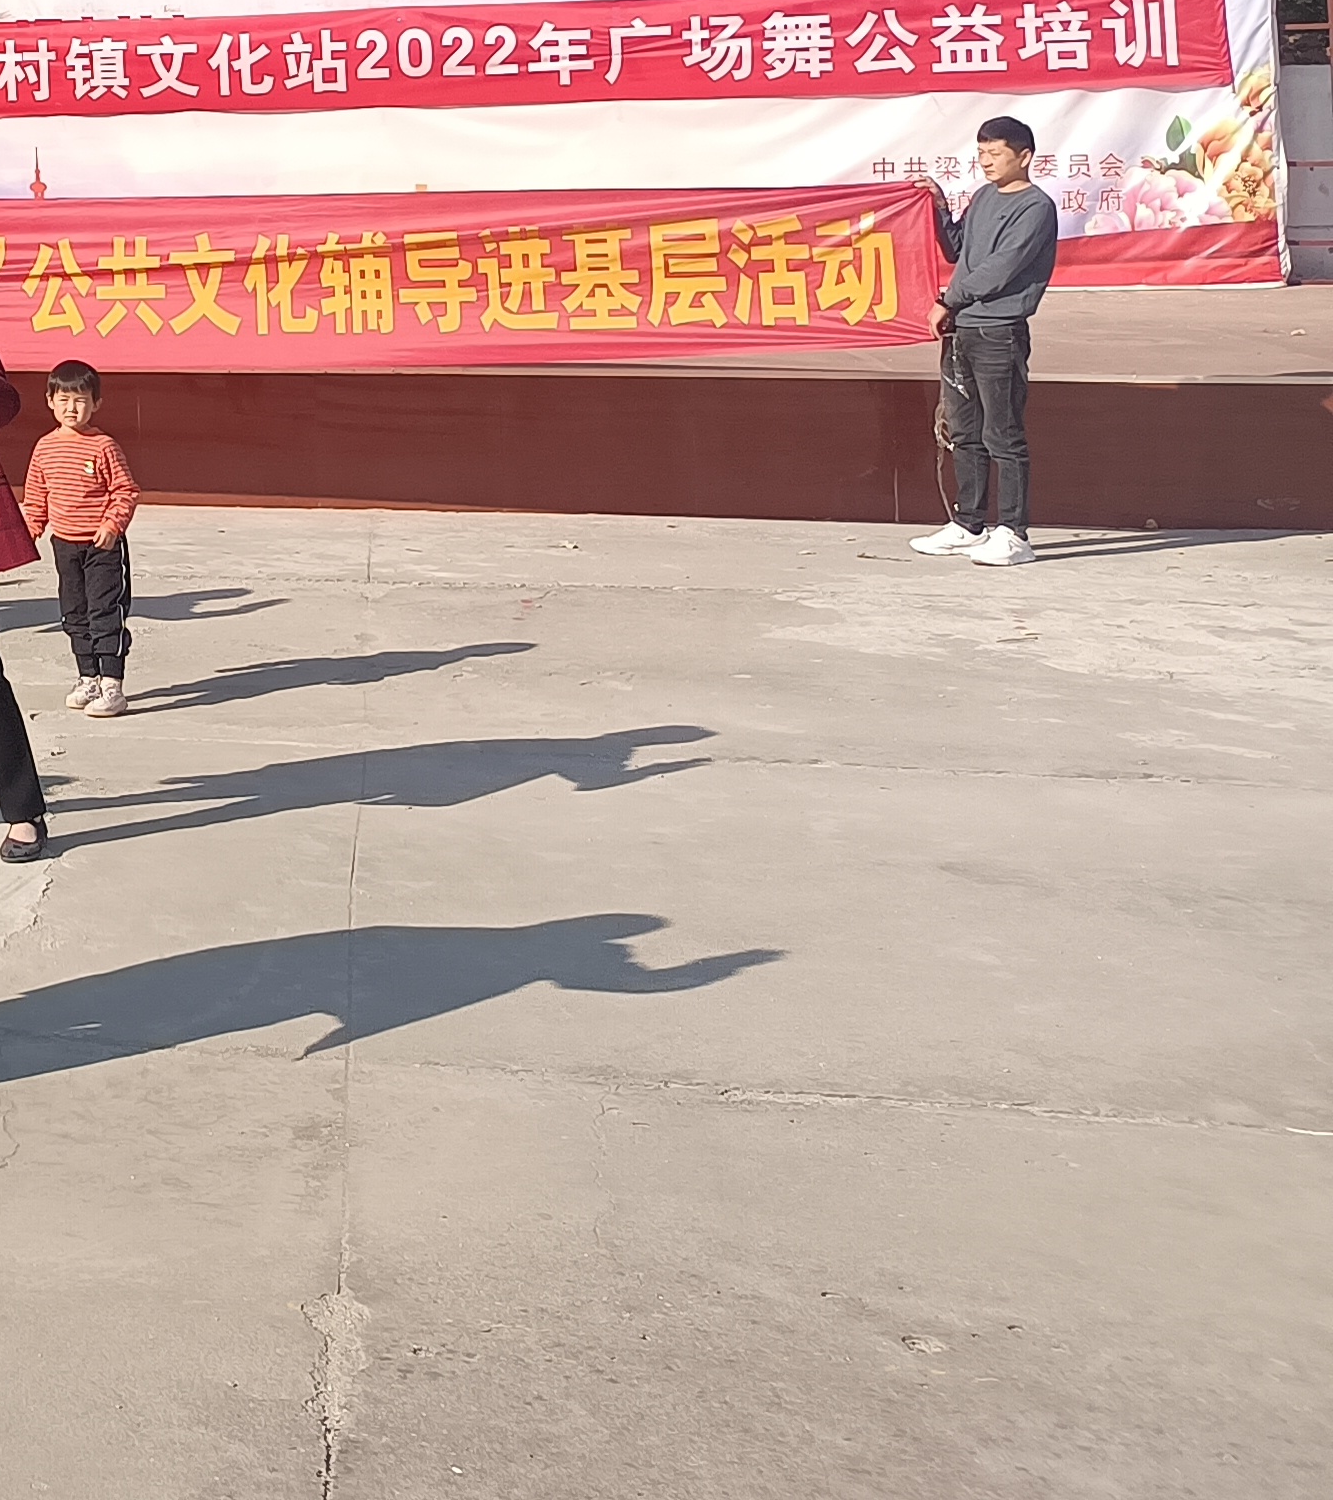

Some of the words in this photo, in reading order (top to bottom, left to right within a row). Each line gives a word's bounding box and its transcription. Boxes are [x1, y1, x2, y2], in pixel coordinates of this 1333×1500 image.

[873, 152, 1125, 181] 中共梁委员会
